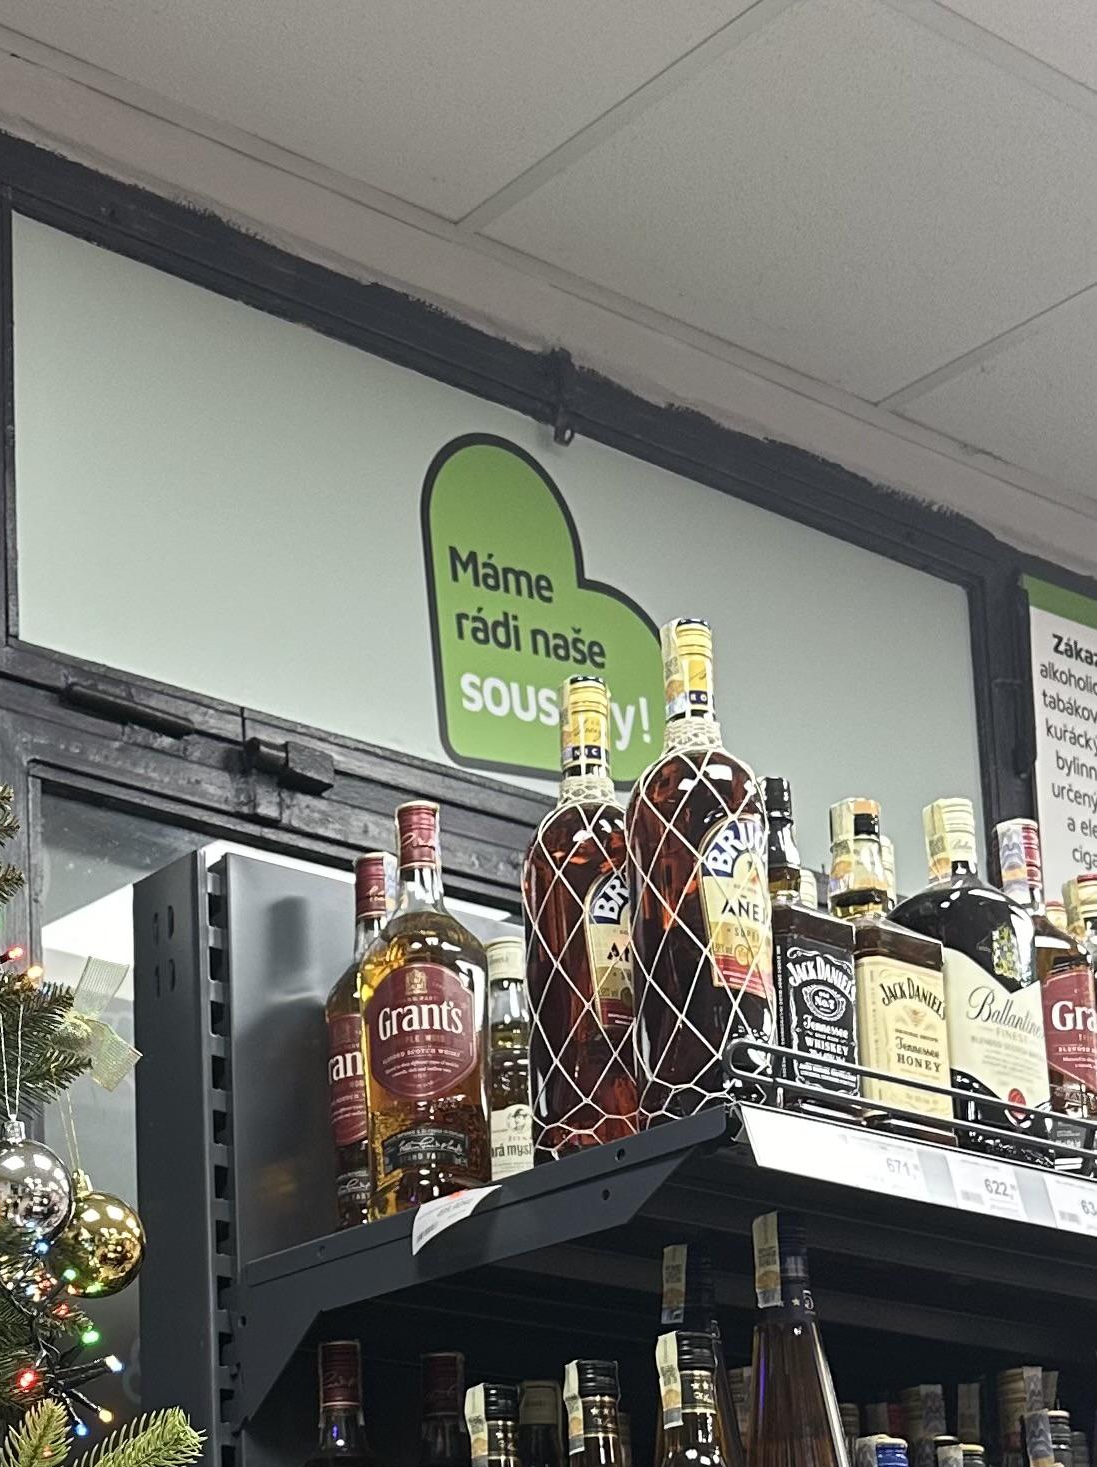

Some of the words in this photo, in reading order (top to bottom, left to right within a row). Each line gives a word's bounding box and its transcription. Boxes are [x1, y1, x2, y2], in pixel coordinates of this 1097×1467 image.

[448, 545, 554, 604] Máme
[455, 606, 521, 652] rádi
[530, 626, 607, 669] naše
[459, 672, 652, 751] sousy!
[1066, 817, 1076, 833] a
[786, 960, 817, 987] JACK
[879, 982, 908, 1007] JACK
[378, 1000, 464, 1041] Grant's
[803, 1014, 849, 1039] Tennessee
[804, 1036, 849, 1056] WHISKEY
[895, 1035, 940, 1059] Tennessee
[897, 1053, 942, 1073] HONEY
